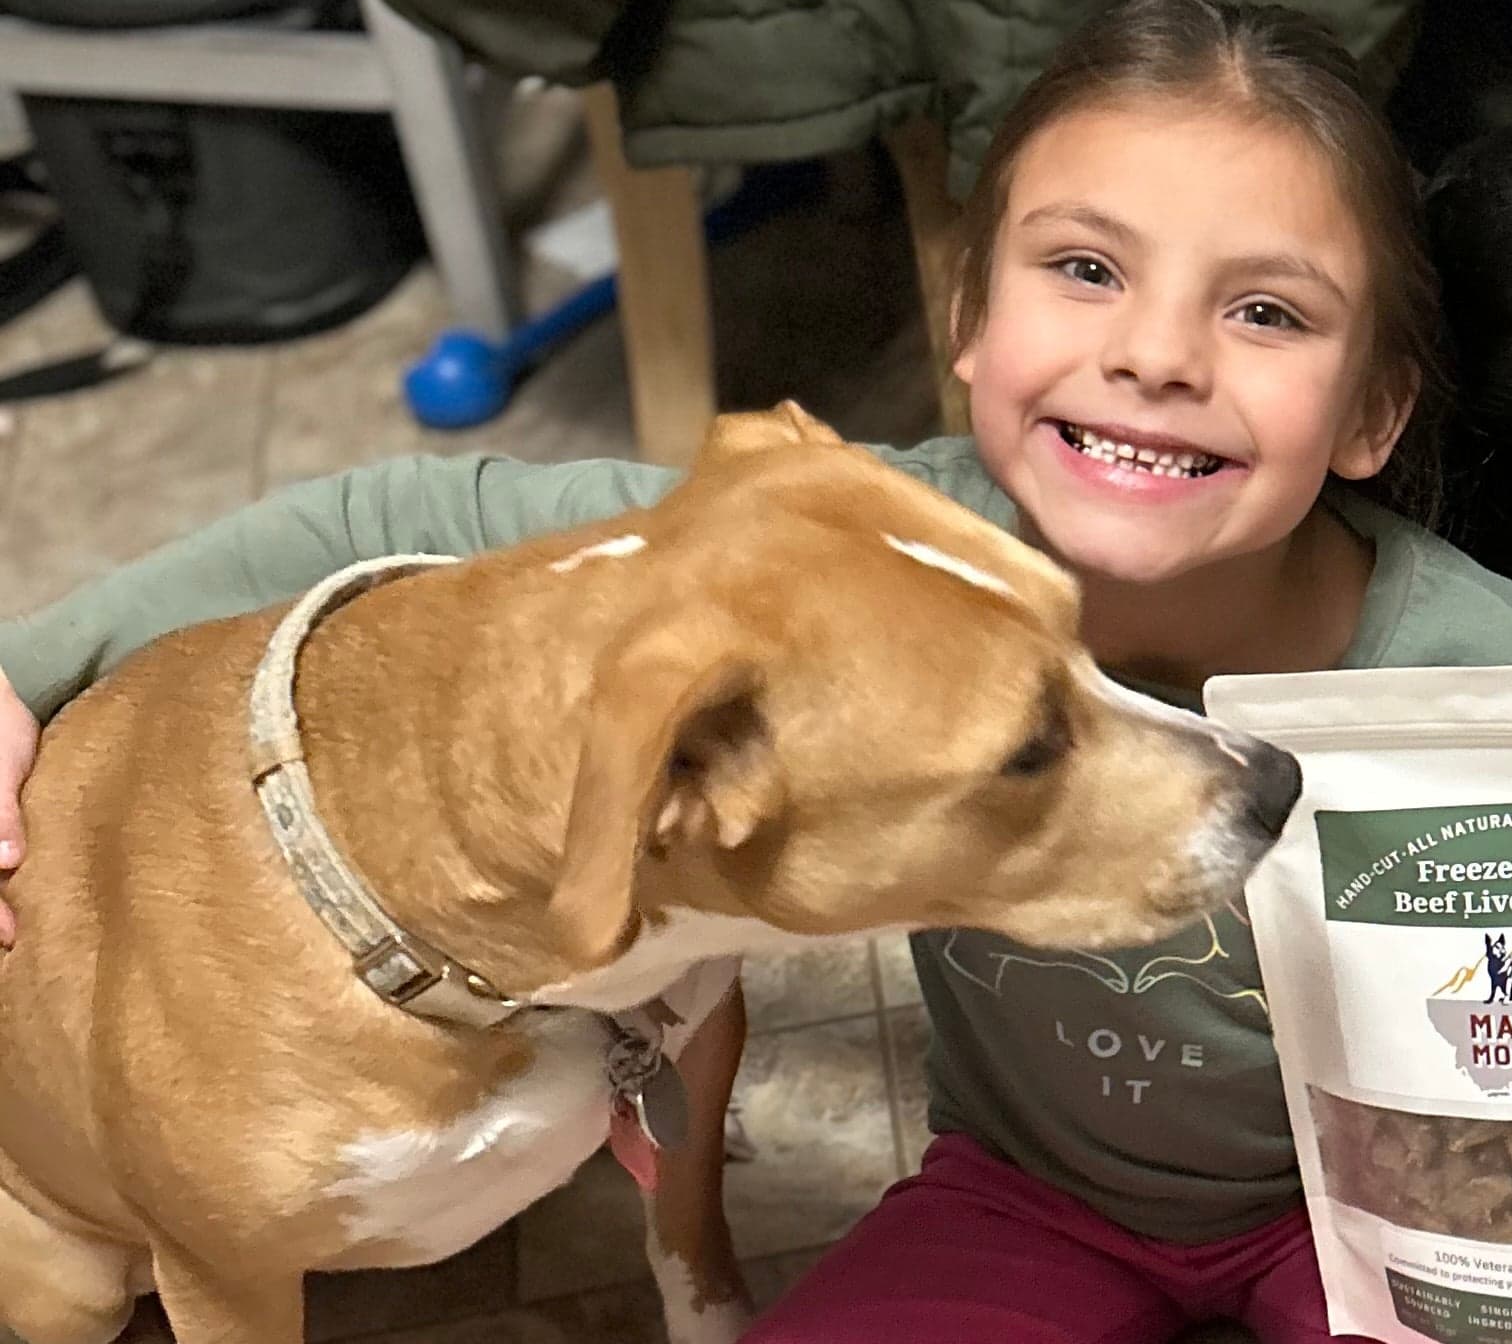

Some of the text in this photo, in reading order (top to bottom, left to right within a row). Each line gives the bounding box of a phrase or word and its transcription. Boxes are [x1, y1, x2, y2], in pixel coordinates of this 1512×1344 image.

[1336, 850, 1401, 910] HAND-CUT
[1394, 889, 1458, 914] Beef
[1055, 1020, 1204, 1068] LOVE
[1101, 1075, 1152, 1104] IT
[1435, 1251, 1470, 1268] 100%
[1452, 1272, 1504, 1289] protecting
